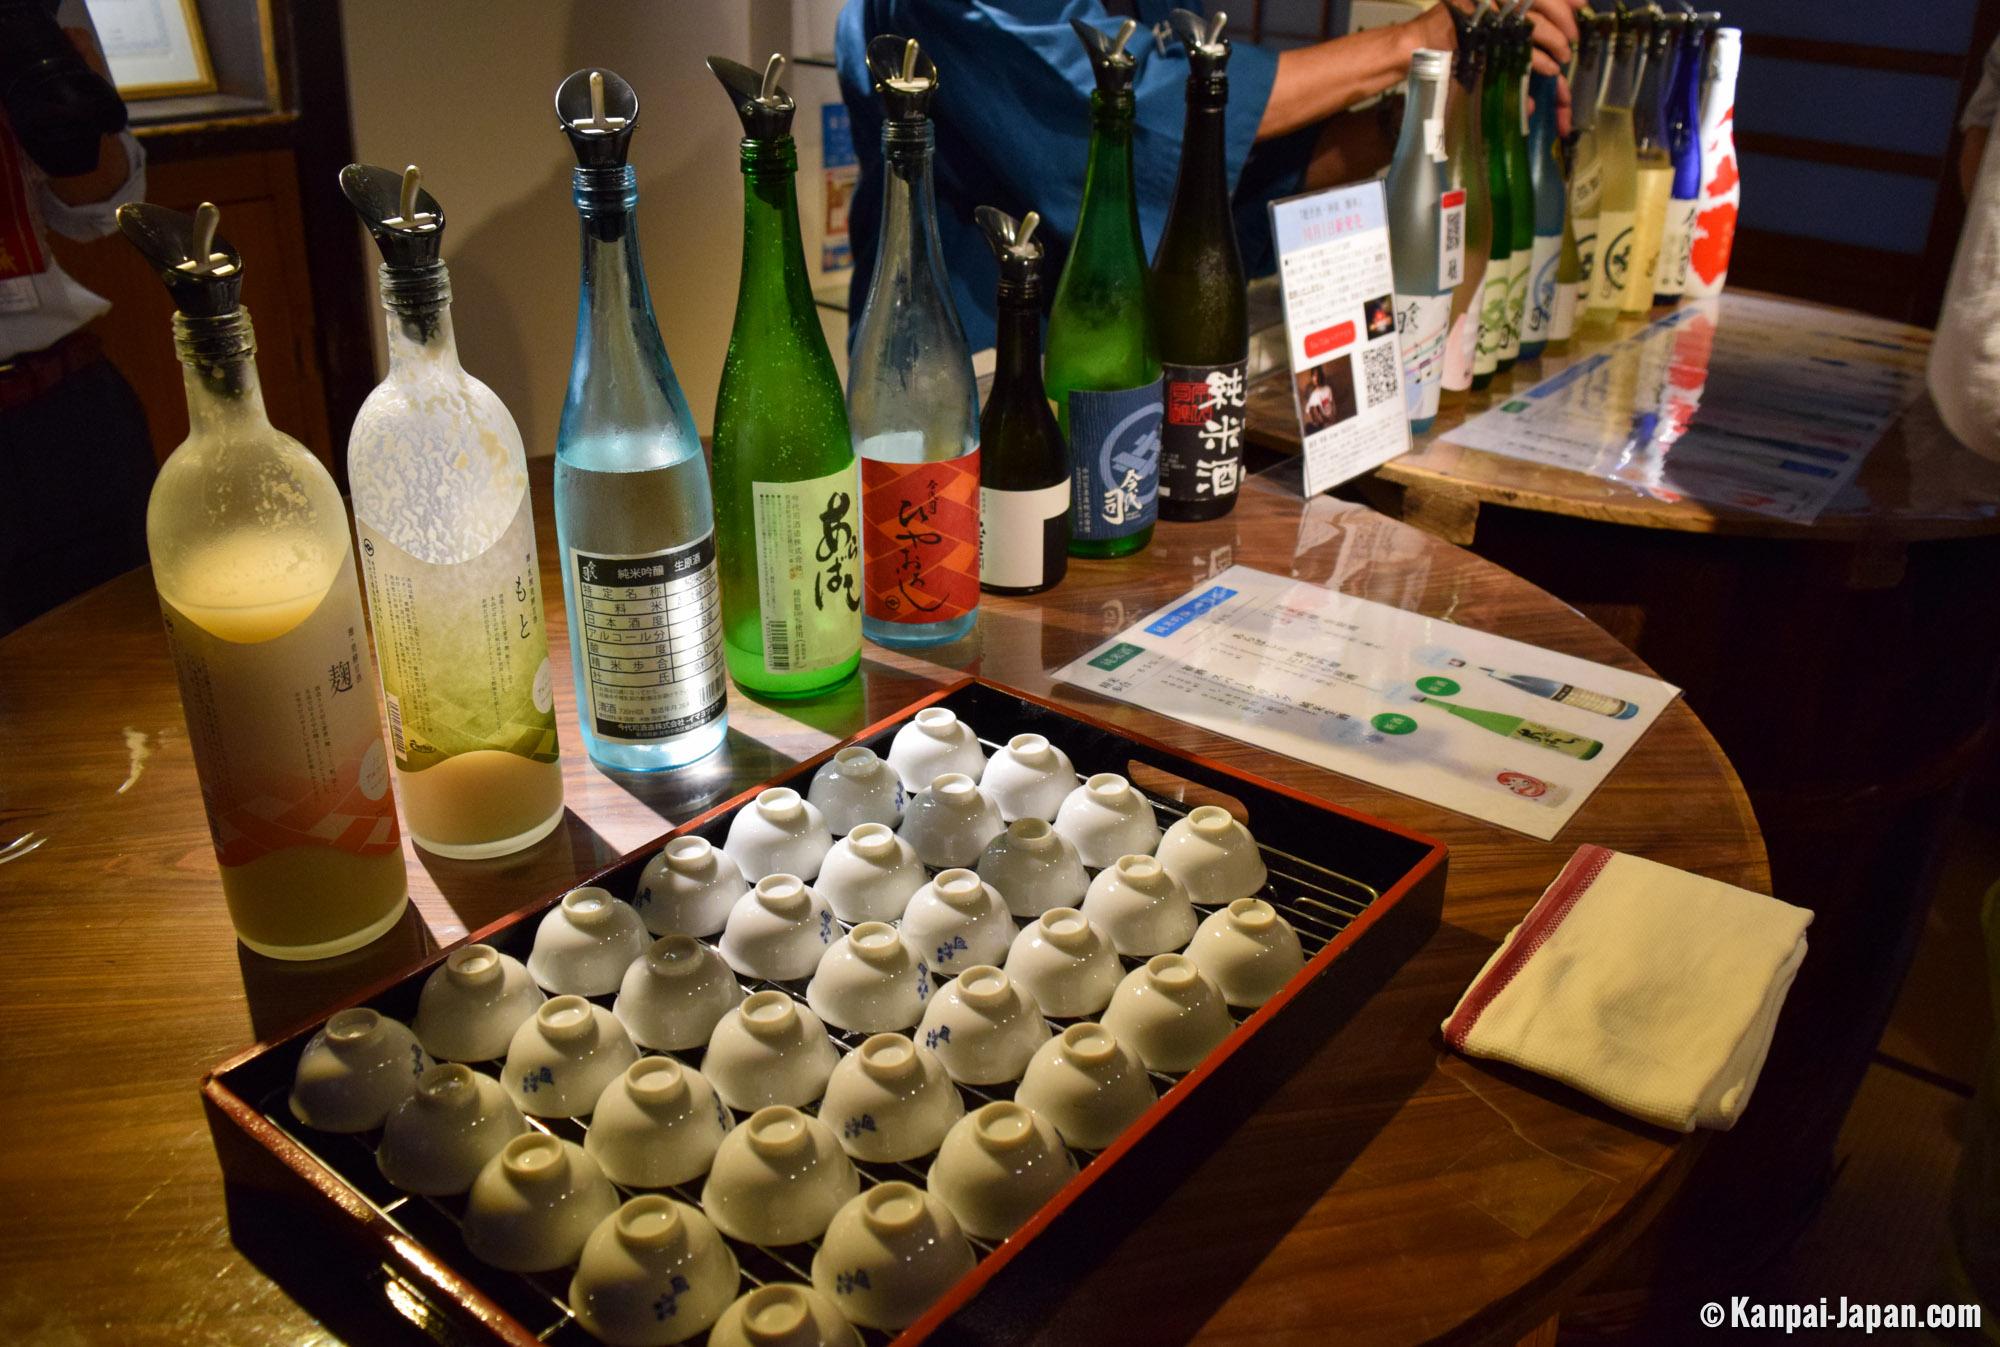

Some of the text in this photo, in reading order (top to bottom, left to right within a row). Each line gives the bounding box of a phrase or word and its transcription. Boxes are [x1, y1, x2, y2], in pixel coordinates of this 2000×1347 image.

[1196, 368, 1246, 496] 純米酒
[586, 613, 665, 629] 日本酒度
[588, 627, 666, 643] アルコール分
